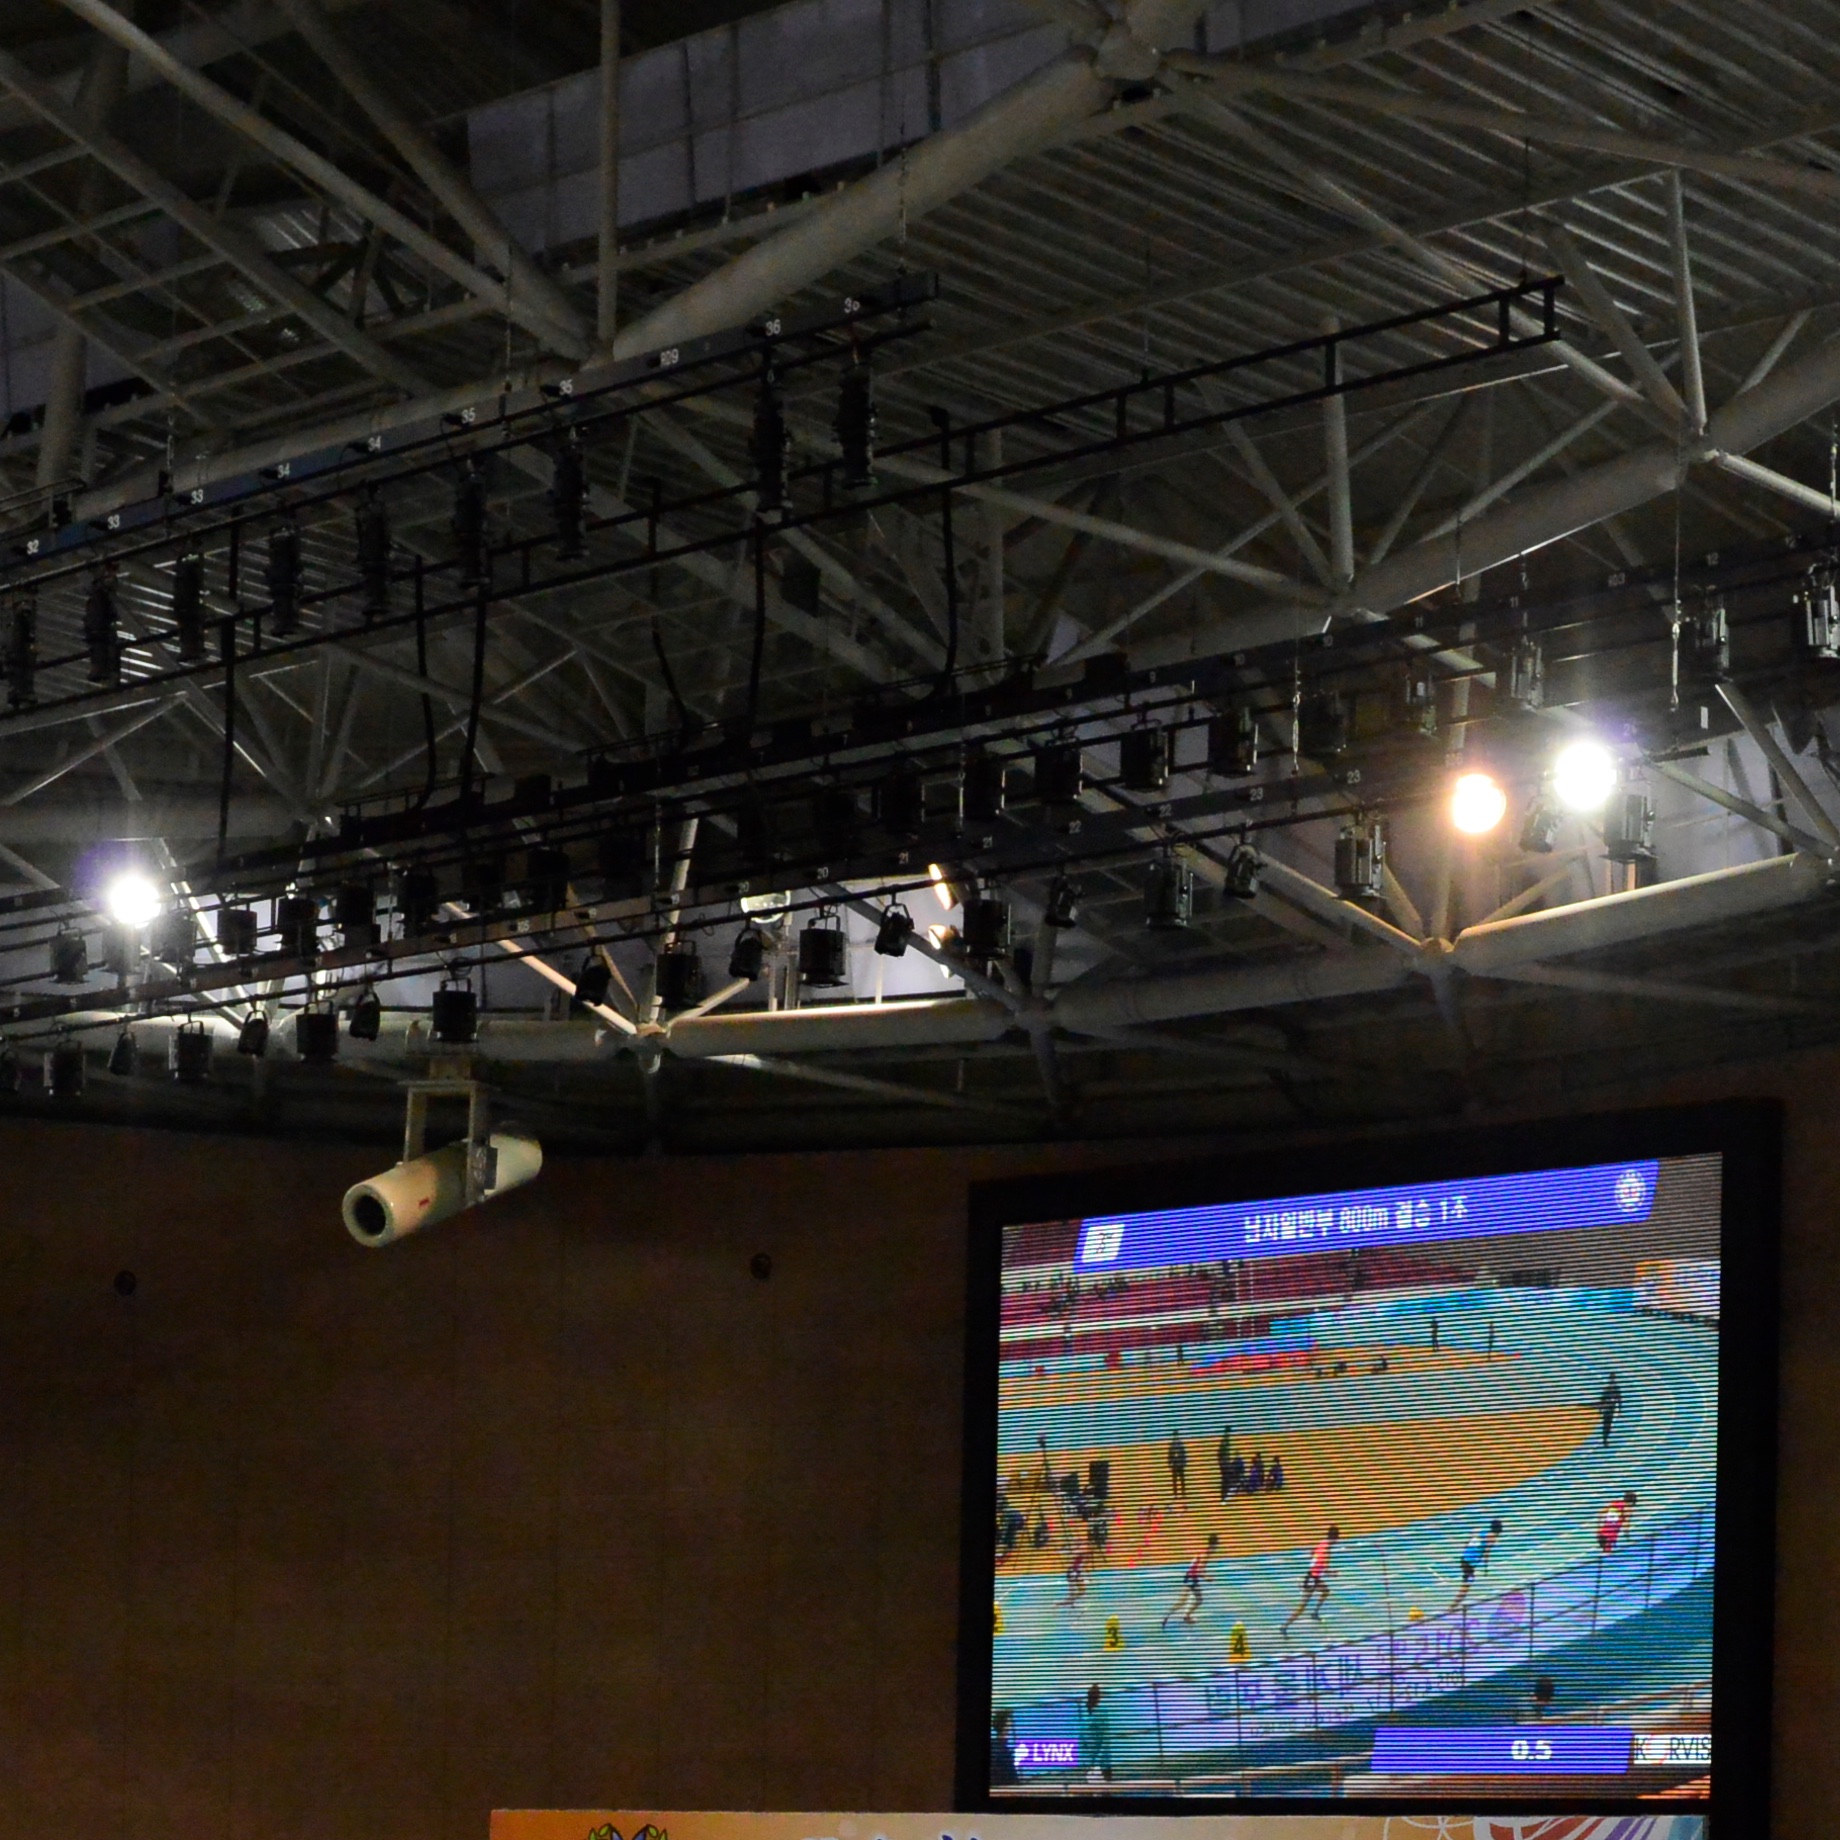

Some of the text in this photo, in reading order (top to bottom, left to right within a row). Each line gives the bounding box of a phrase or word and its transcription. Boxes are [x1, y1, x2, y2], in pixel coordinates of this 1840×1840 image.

[765, 318, 781, 336] 36
[461, 407, 476, 424] 35
[368, 435, 381, 452] 34
[277, 462, 290, 479] 34
[190, 489, 204, 505] 33
[107, 514, 120, 530] 33
[1346, 769, 1361, 784] 23
[1249, 787, 1264, 802] 23
[1158, 803, 1173, 817] 22
[1068, 820, 1082, 834] 22
[898, 851, 909, 865] 21
[1339, 1205, 1389, 1234] 800m
[1439, 1196, 1468, 1223] 1조
[1032, 1742, 1075, 1763] LYNX
[1510, 1739, 1553, 1761] 0.5
